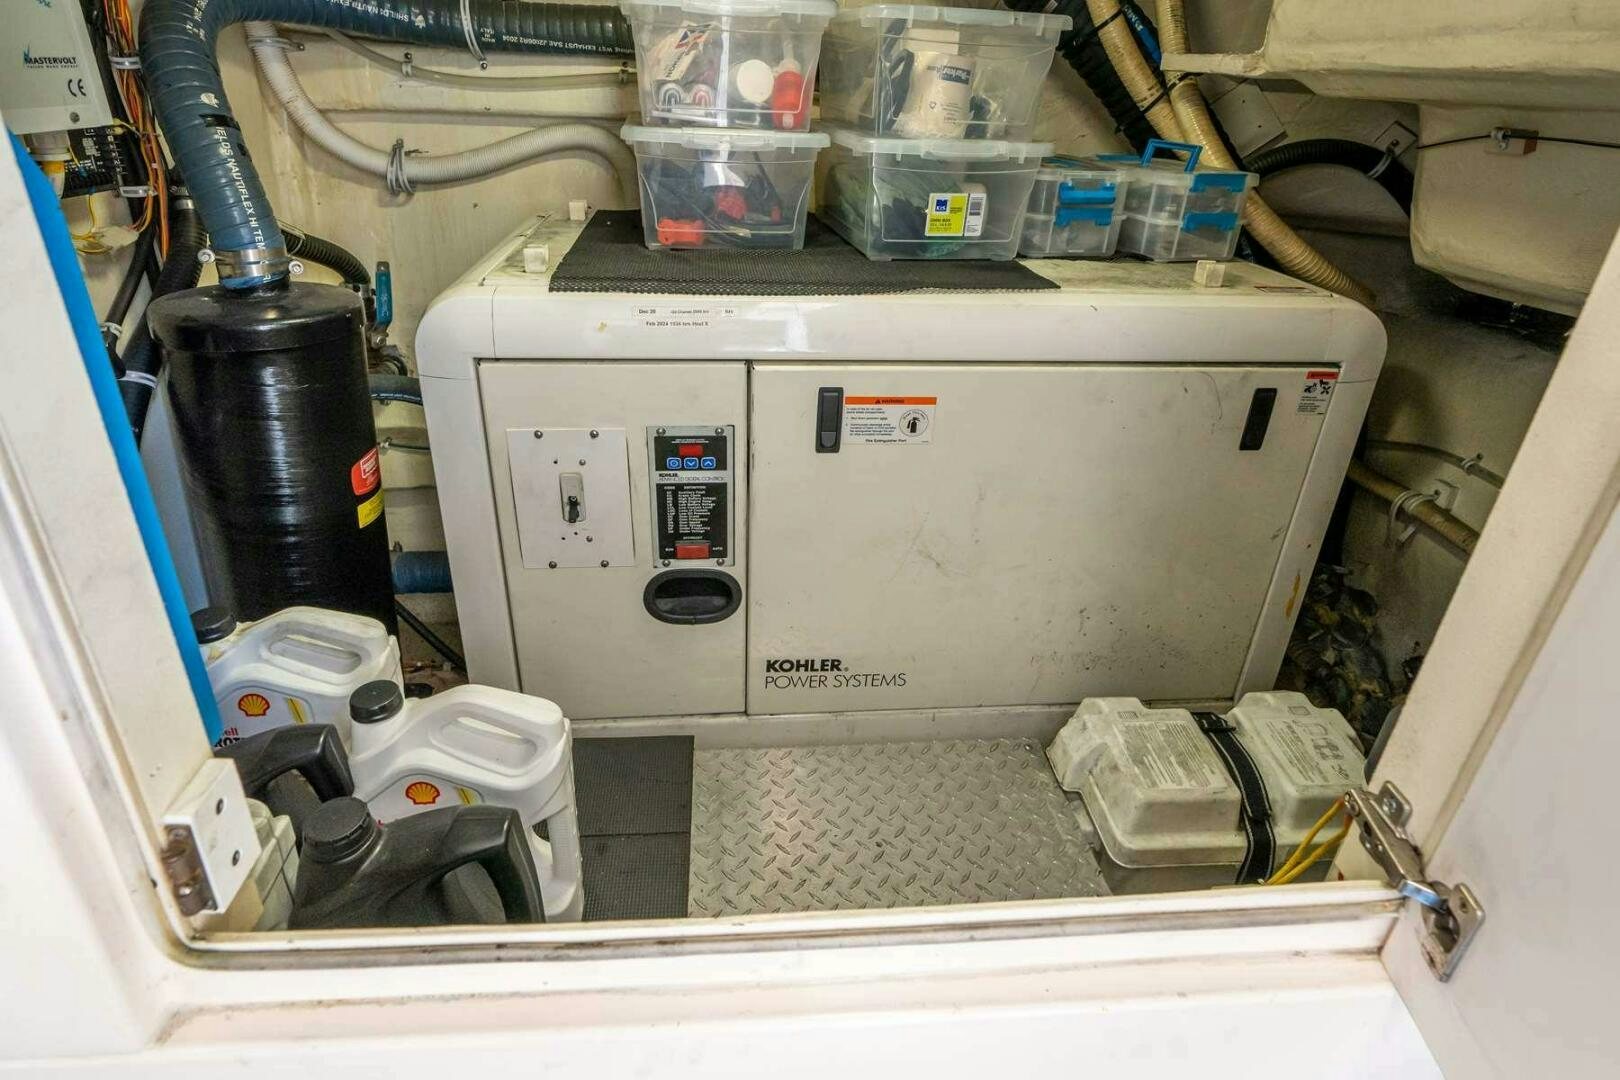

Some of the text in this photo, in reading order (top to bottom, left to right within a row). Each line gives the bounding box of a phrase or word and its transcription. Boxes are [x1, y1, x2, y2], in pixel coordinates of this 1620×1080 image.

[24, 53, 77, 65] MASTERVOLT
[226, 158, 256, 216] NAUTIFLEX
[254, 229, 267, 250] TEM
[766, 659, 842, 673] KOHLER
[765, 672, 907, 689] POWER SYSTEMS
